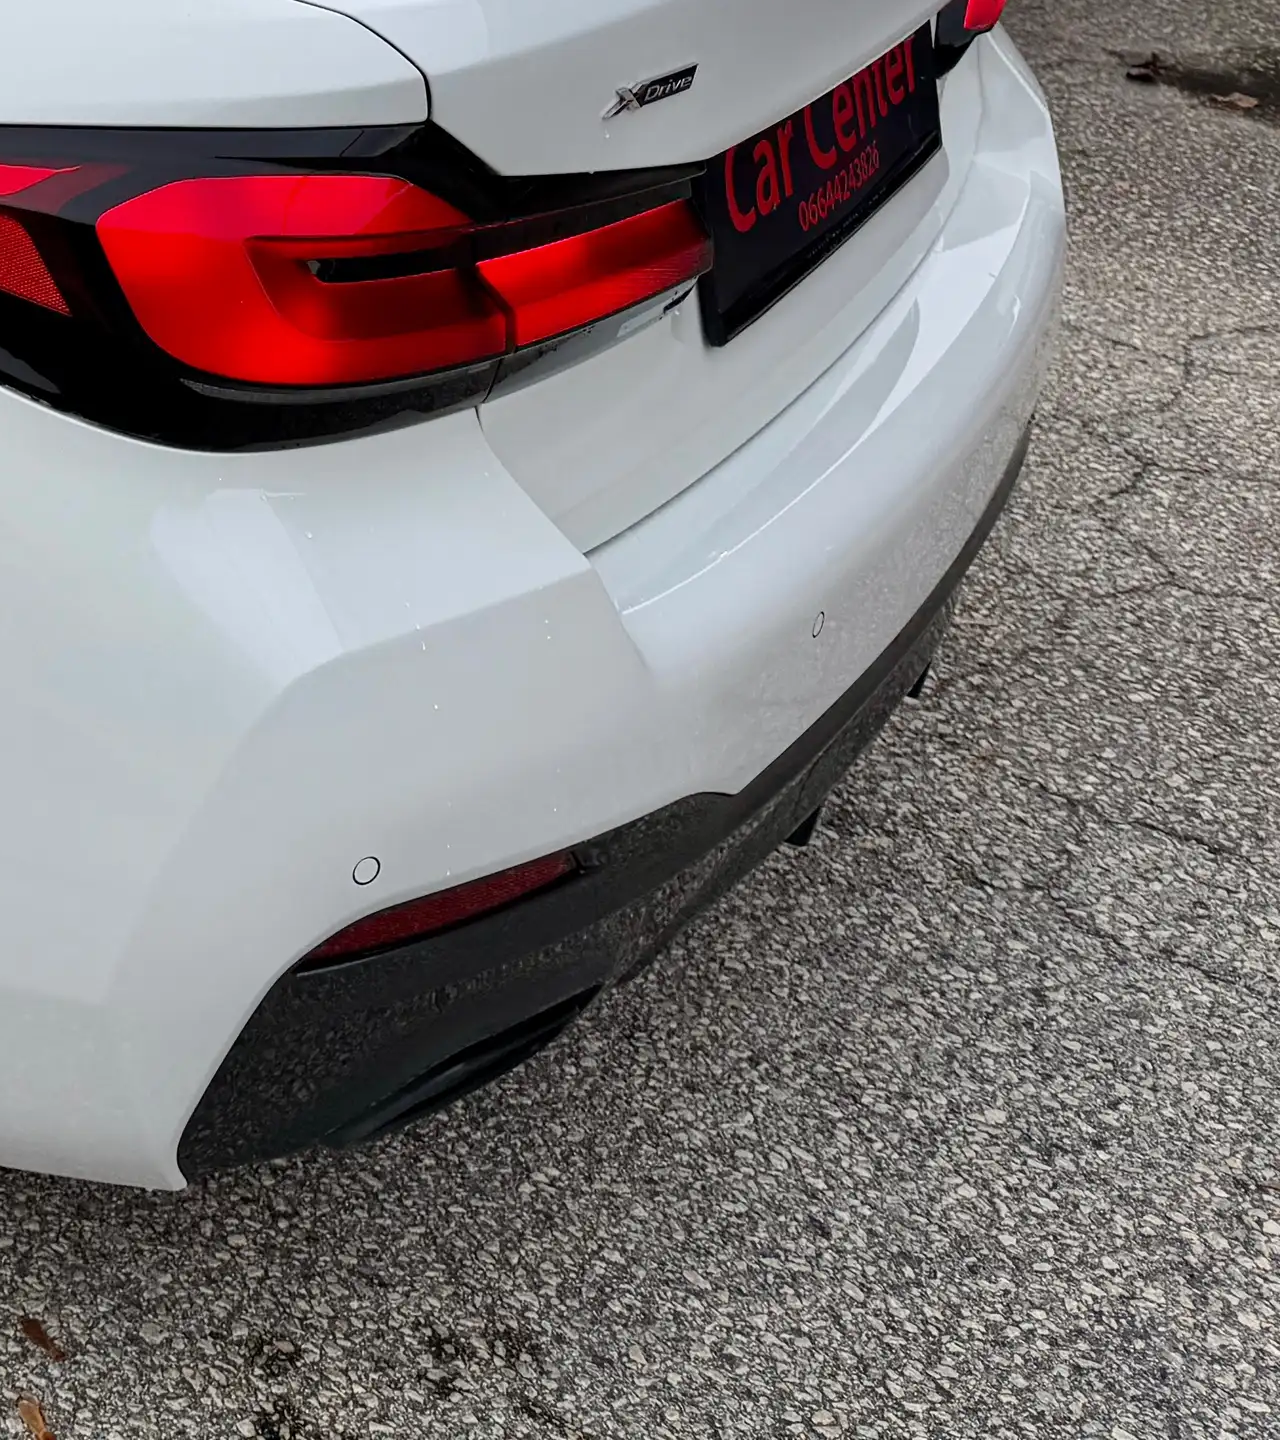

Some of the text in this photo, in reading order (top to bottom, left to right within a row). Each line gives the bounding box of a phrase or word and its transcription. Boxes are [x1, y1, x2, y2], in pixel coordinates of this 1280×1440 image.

[724, 120, 794, 233] Car
[804, 36, 915, 171] Center
[798, 140, 880, 233] 06644243826
